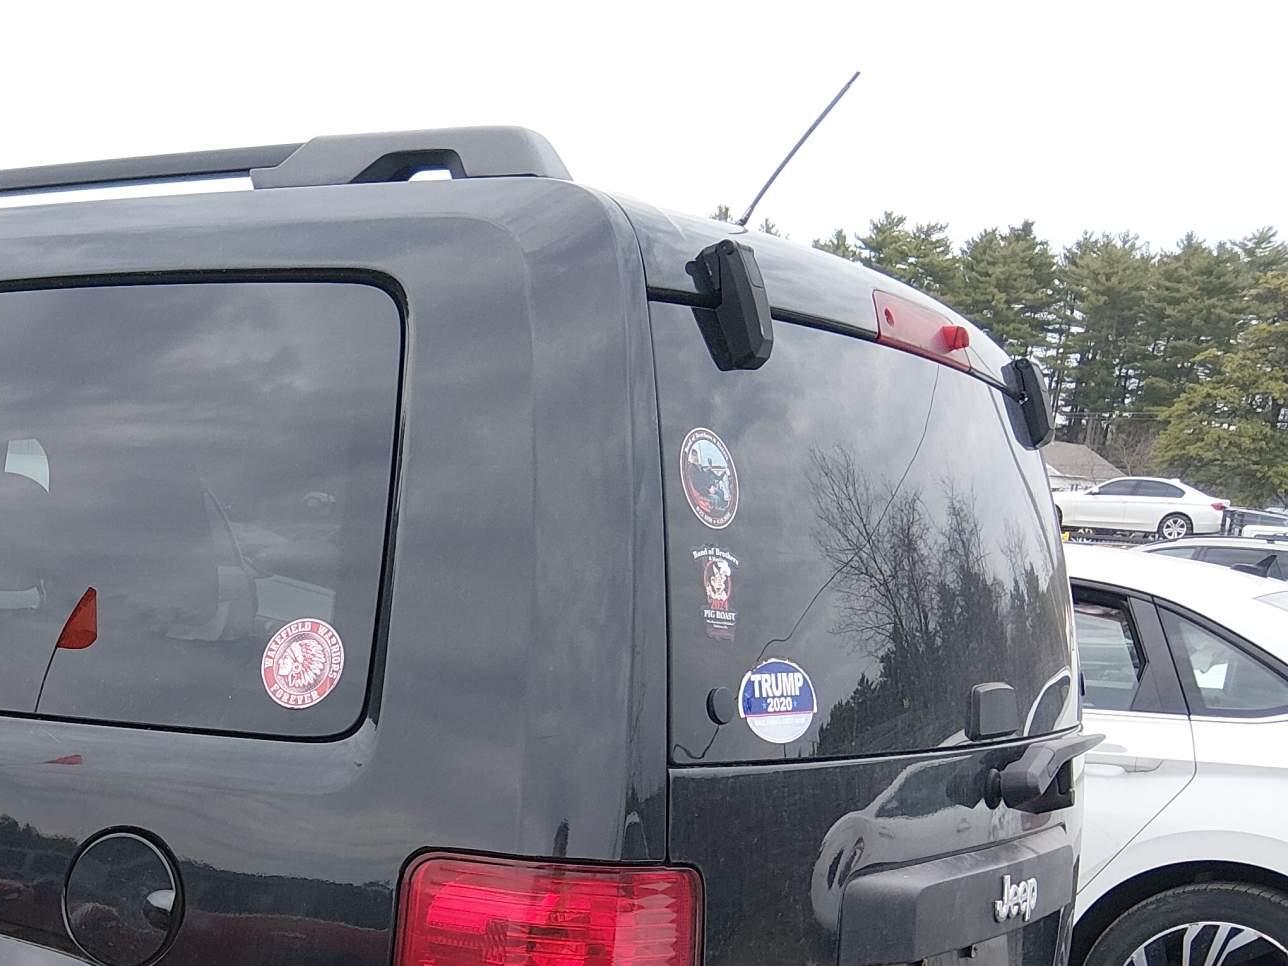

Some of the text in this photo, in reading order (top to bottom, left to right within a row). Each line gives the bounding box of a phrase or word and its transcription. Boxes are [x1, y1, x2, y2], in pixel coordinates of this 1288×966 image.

[703, 609, 716, 618] PIG
[264, 621, 341, 680] WAKEFIELD WARRIORS
[270, 684, 320, 705] FOREVER
[750, 672, 804, 698] TRUMP
[767, 697, 793, 712] 2020
[993, 874, 1038, 922] Jeep
